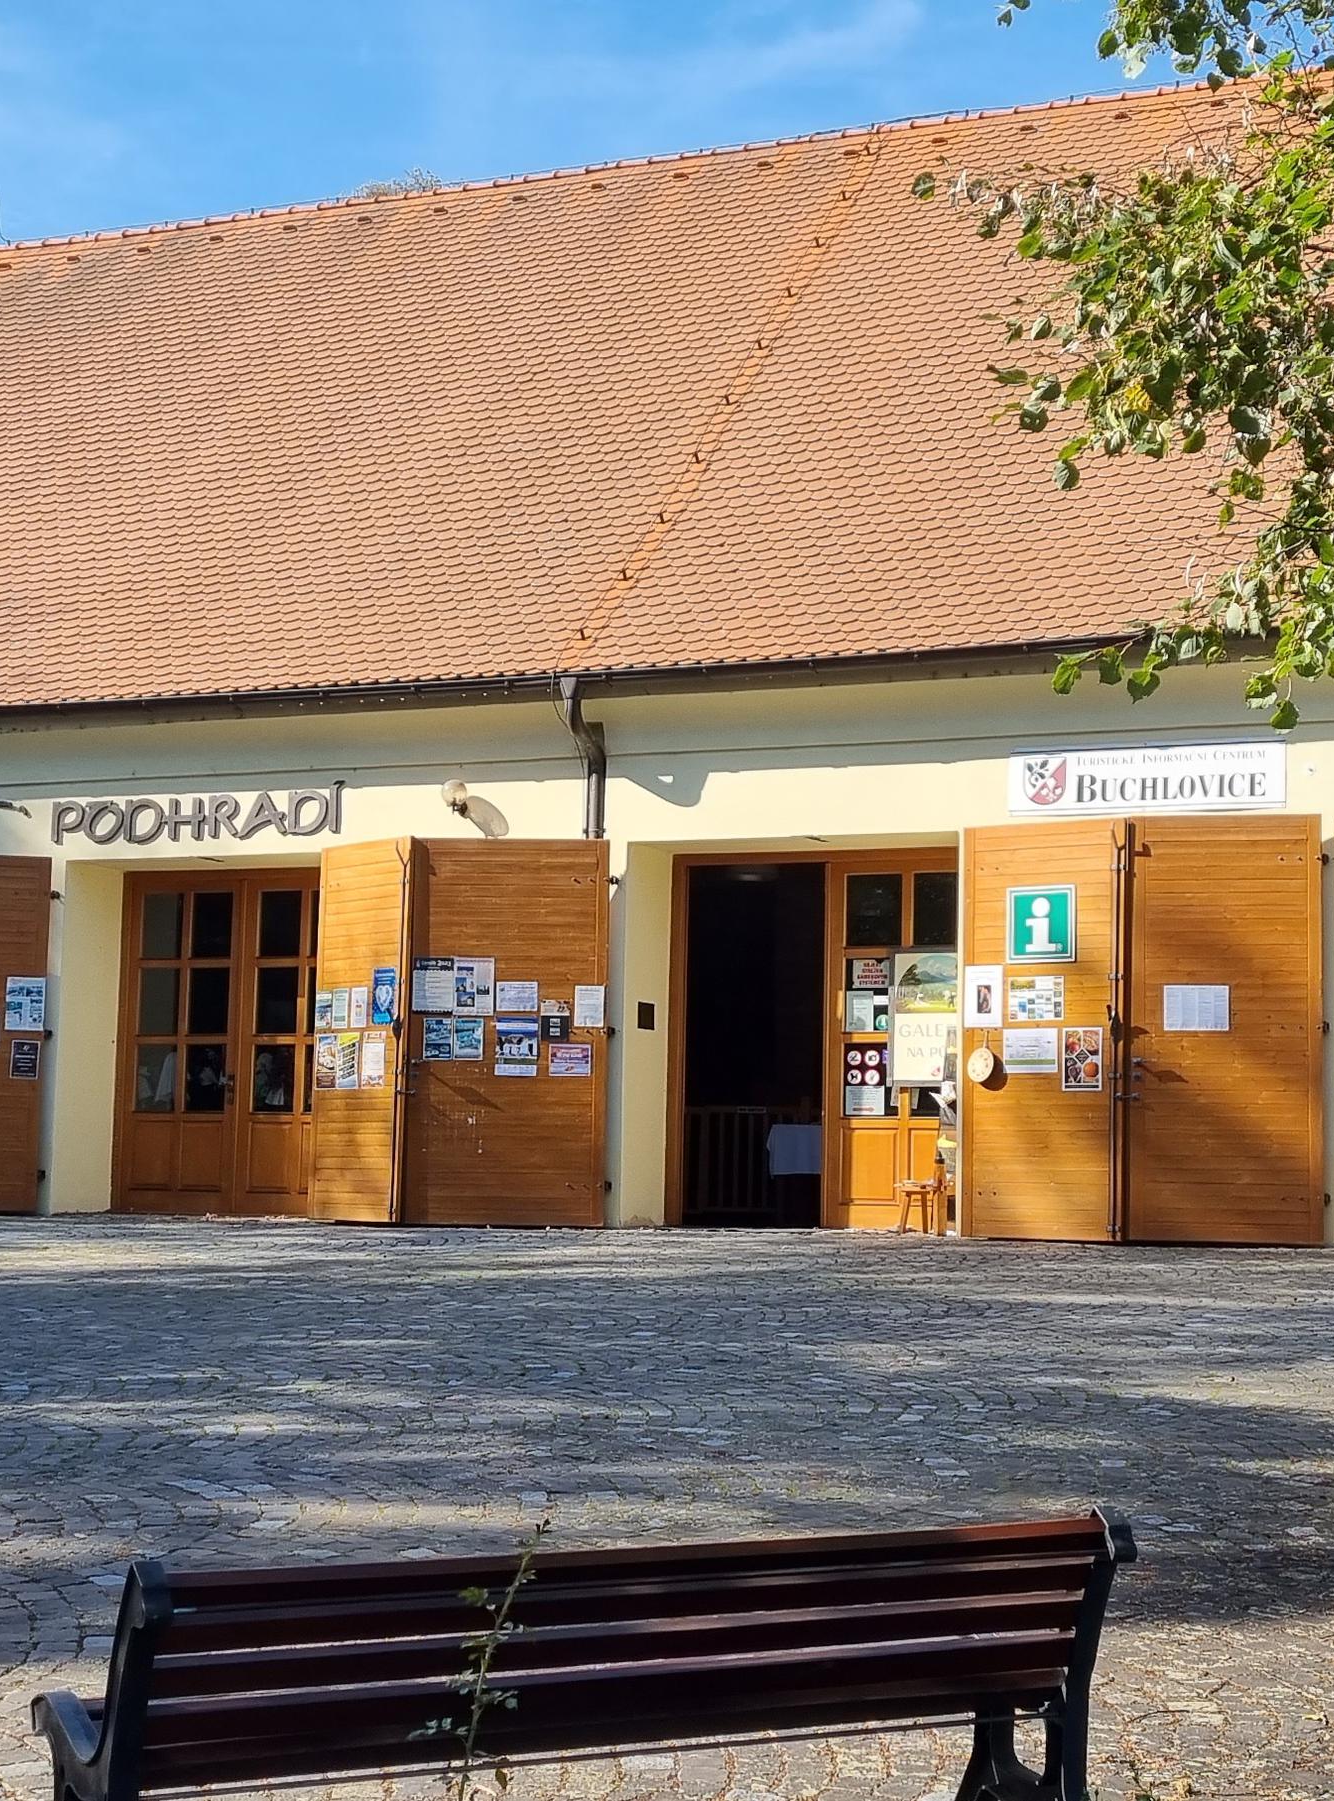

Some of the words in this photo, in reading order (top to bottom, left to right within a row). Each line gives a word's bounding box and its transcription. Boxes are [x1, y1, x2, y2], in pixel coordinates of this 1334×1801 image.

[1076, 754, 1136, 767] TURISTICKÉ
[1213, 750, 1266, 761] CENTRUM
[1075, 772, 1267, 803] BUCHLOVICE
[51, 780, 345, 846] PODHRADÍ
[899, 1023, 944, 1038] GALE
[907, 1047, 924, 1058] NA
